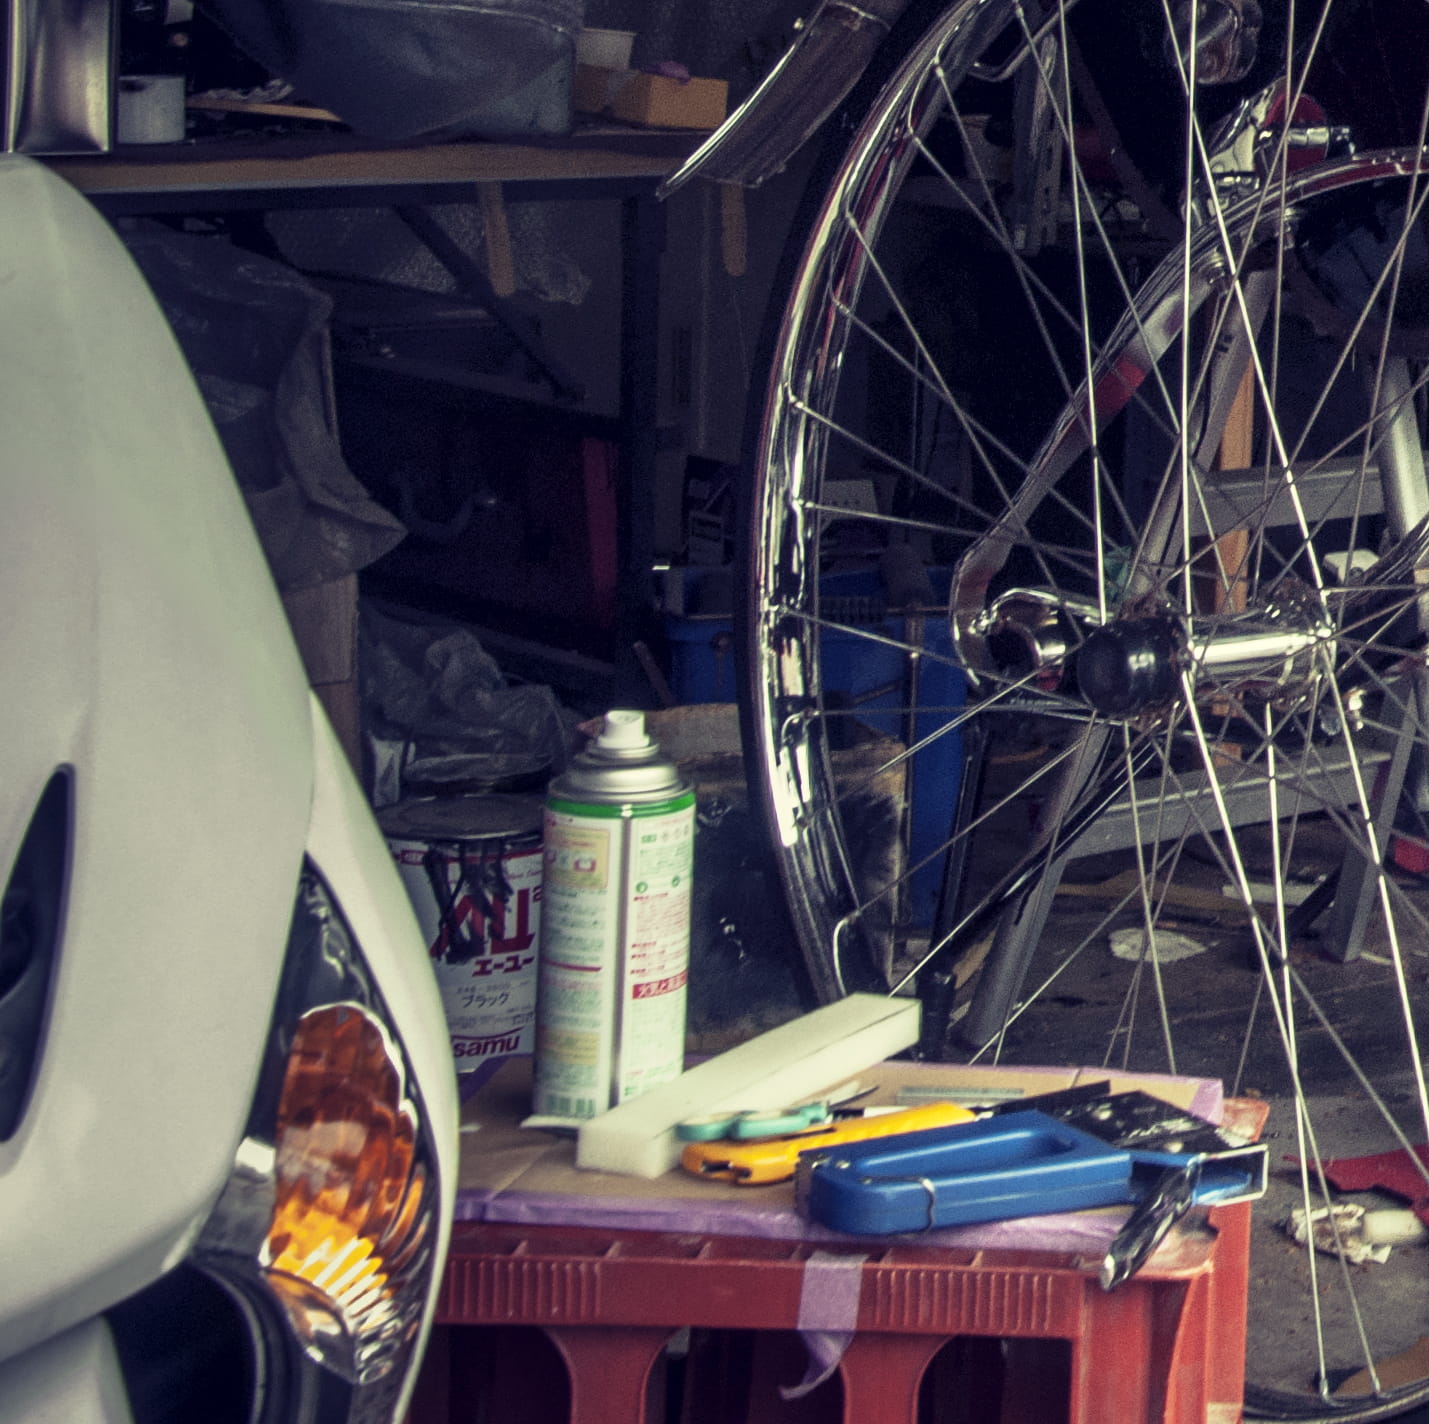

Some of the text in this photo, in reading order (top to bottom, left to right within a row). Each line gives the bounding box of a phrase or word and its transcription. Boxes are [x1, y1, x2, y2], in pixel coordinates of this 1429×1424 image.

[471, 954, 536, 978] エーユー
[462, 991, 510, 1009] ブラック
[452, 1034, 520, 1059] samu
